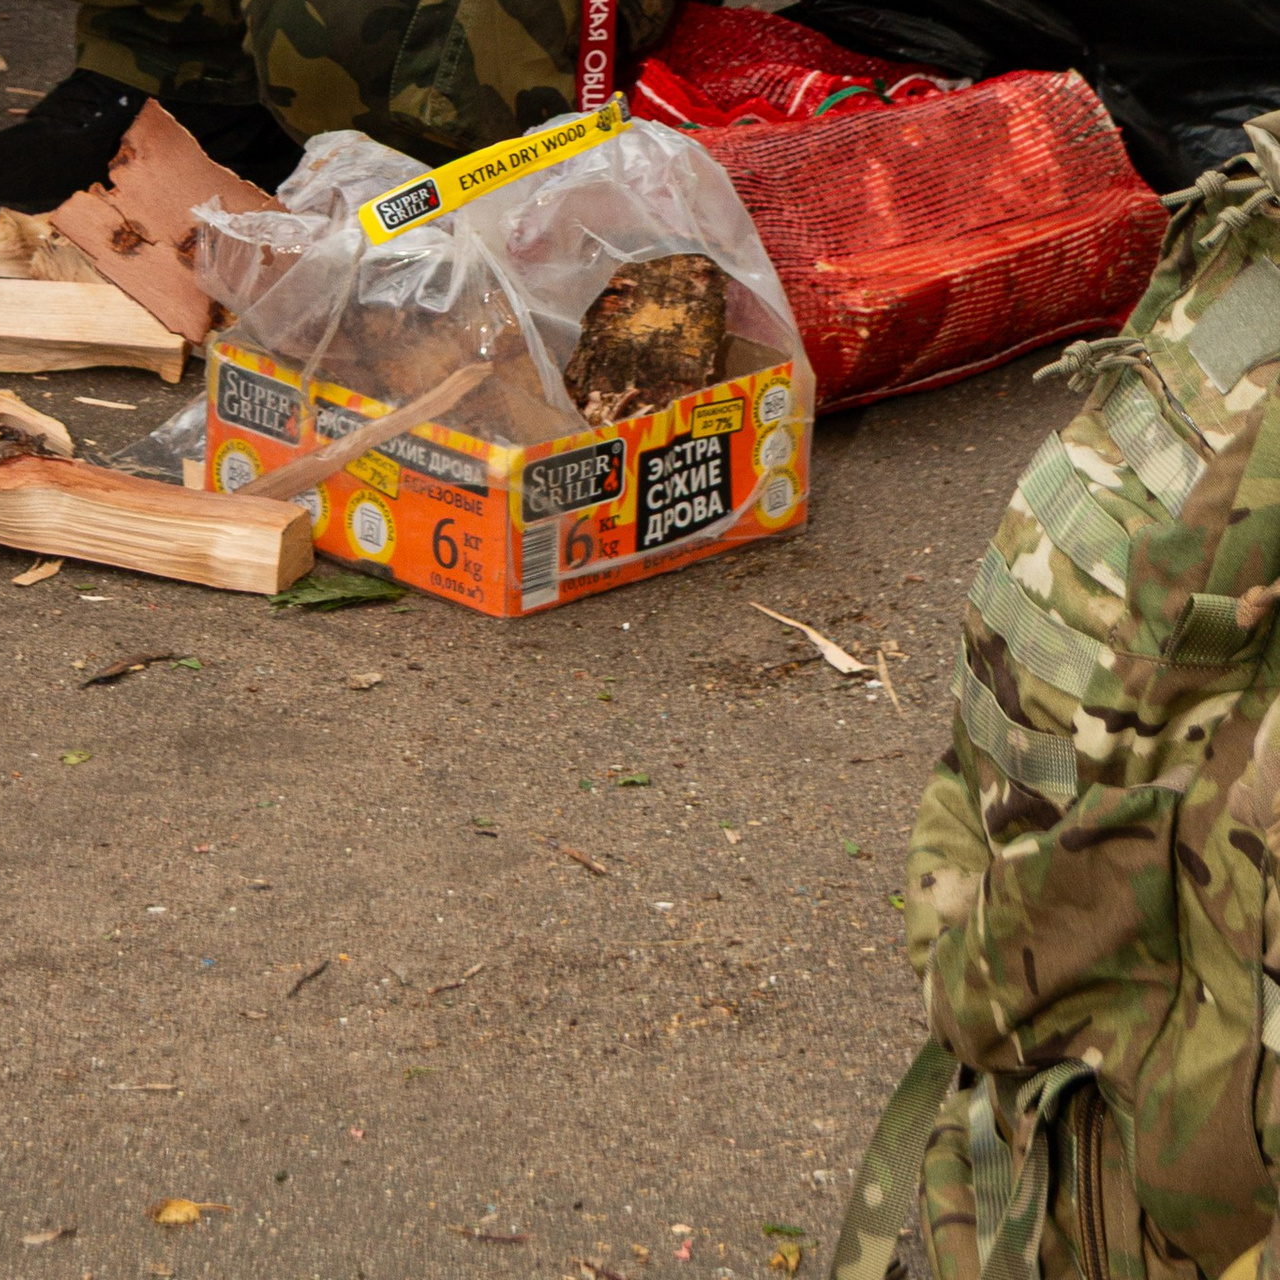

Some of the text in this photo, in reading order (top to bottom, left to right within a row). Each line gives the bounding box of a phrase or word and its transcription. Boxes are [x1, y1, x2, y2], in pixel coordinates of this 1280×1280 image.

[582, 49, 608, 113] ОБЩ
[459, 124, 586, 190] EXTRA DRY WOOD
[381, 188, 431, 215] SUPER
[385, 202, 429, 226] GRILL
[223, 390, 286, 433] GRILL
[226, 370, 291, 416] SUPER
[715, 416, 733, 431] 7%
[428, 452, 484, 483] ДРОВА
[531, 454, 611, 490] SUPER
[647, 436, 722, 481] ЭКСТРА
[529, 476, 602, 514] GRILL
[646, 459, 722, 510] СУХИЕ
[644, 490, 724, 546] ДРОВА
[433, 517, 459, 569] 6
[565, 514, 593, 570] 6
[600, 538, 620, 559] kg
[429, 571, 465, 595] (0,016
[463, 552, 483, 582] kg
